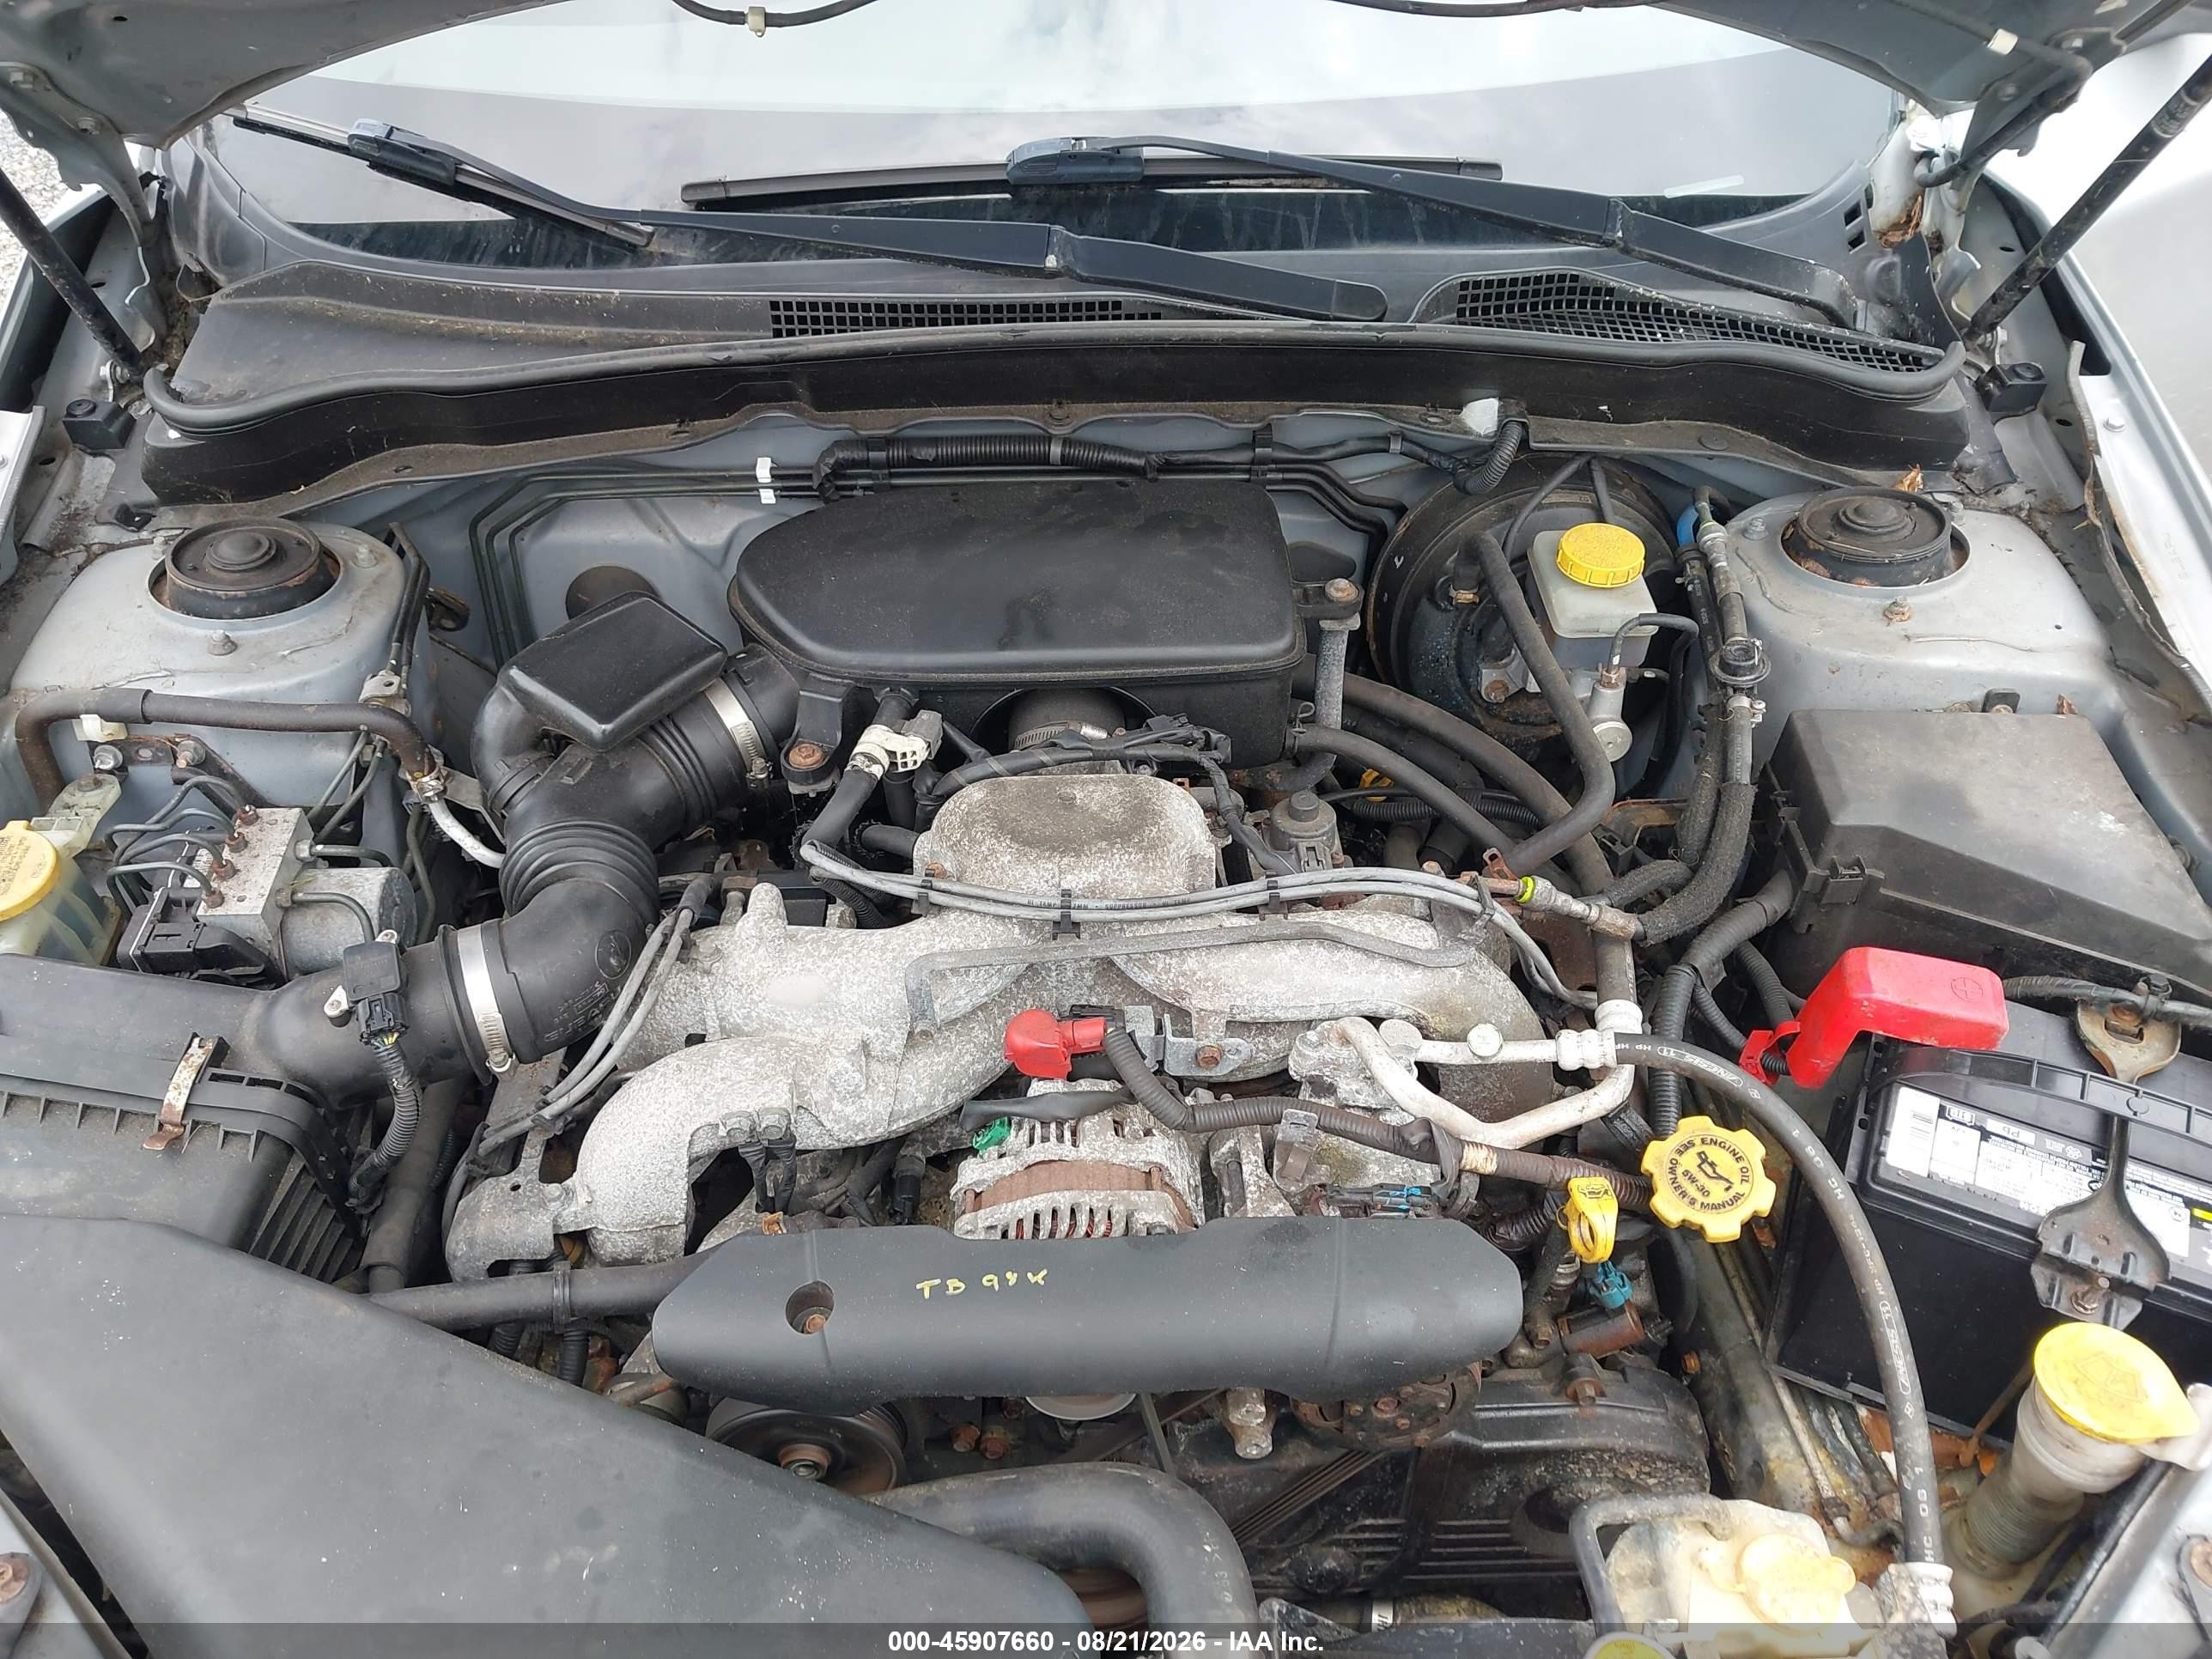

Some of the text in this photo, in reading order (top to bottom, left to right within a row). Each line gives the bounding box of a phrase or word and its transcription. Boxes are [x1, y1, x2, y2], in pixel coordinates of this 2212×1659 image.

[2002, 1126, 2021, 1139] Pb
[1668, 1139, 1746, 1211] SEE OWNER'S MANUAL
[1700, 1137, 1750, 1185] ENGINE OIL
